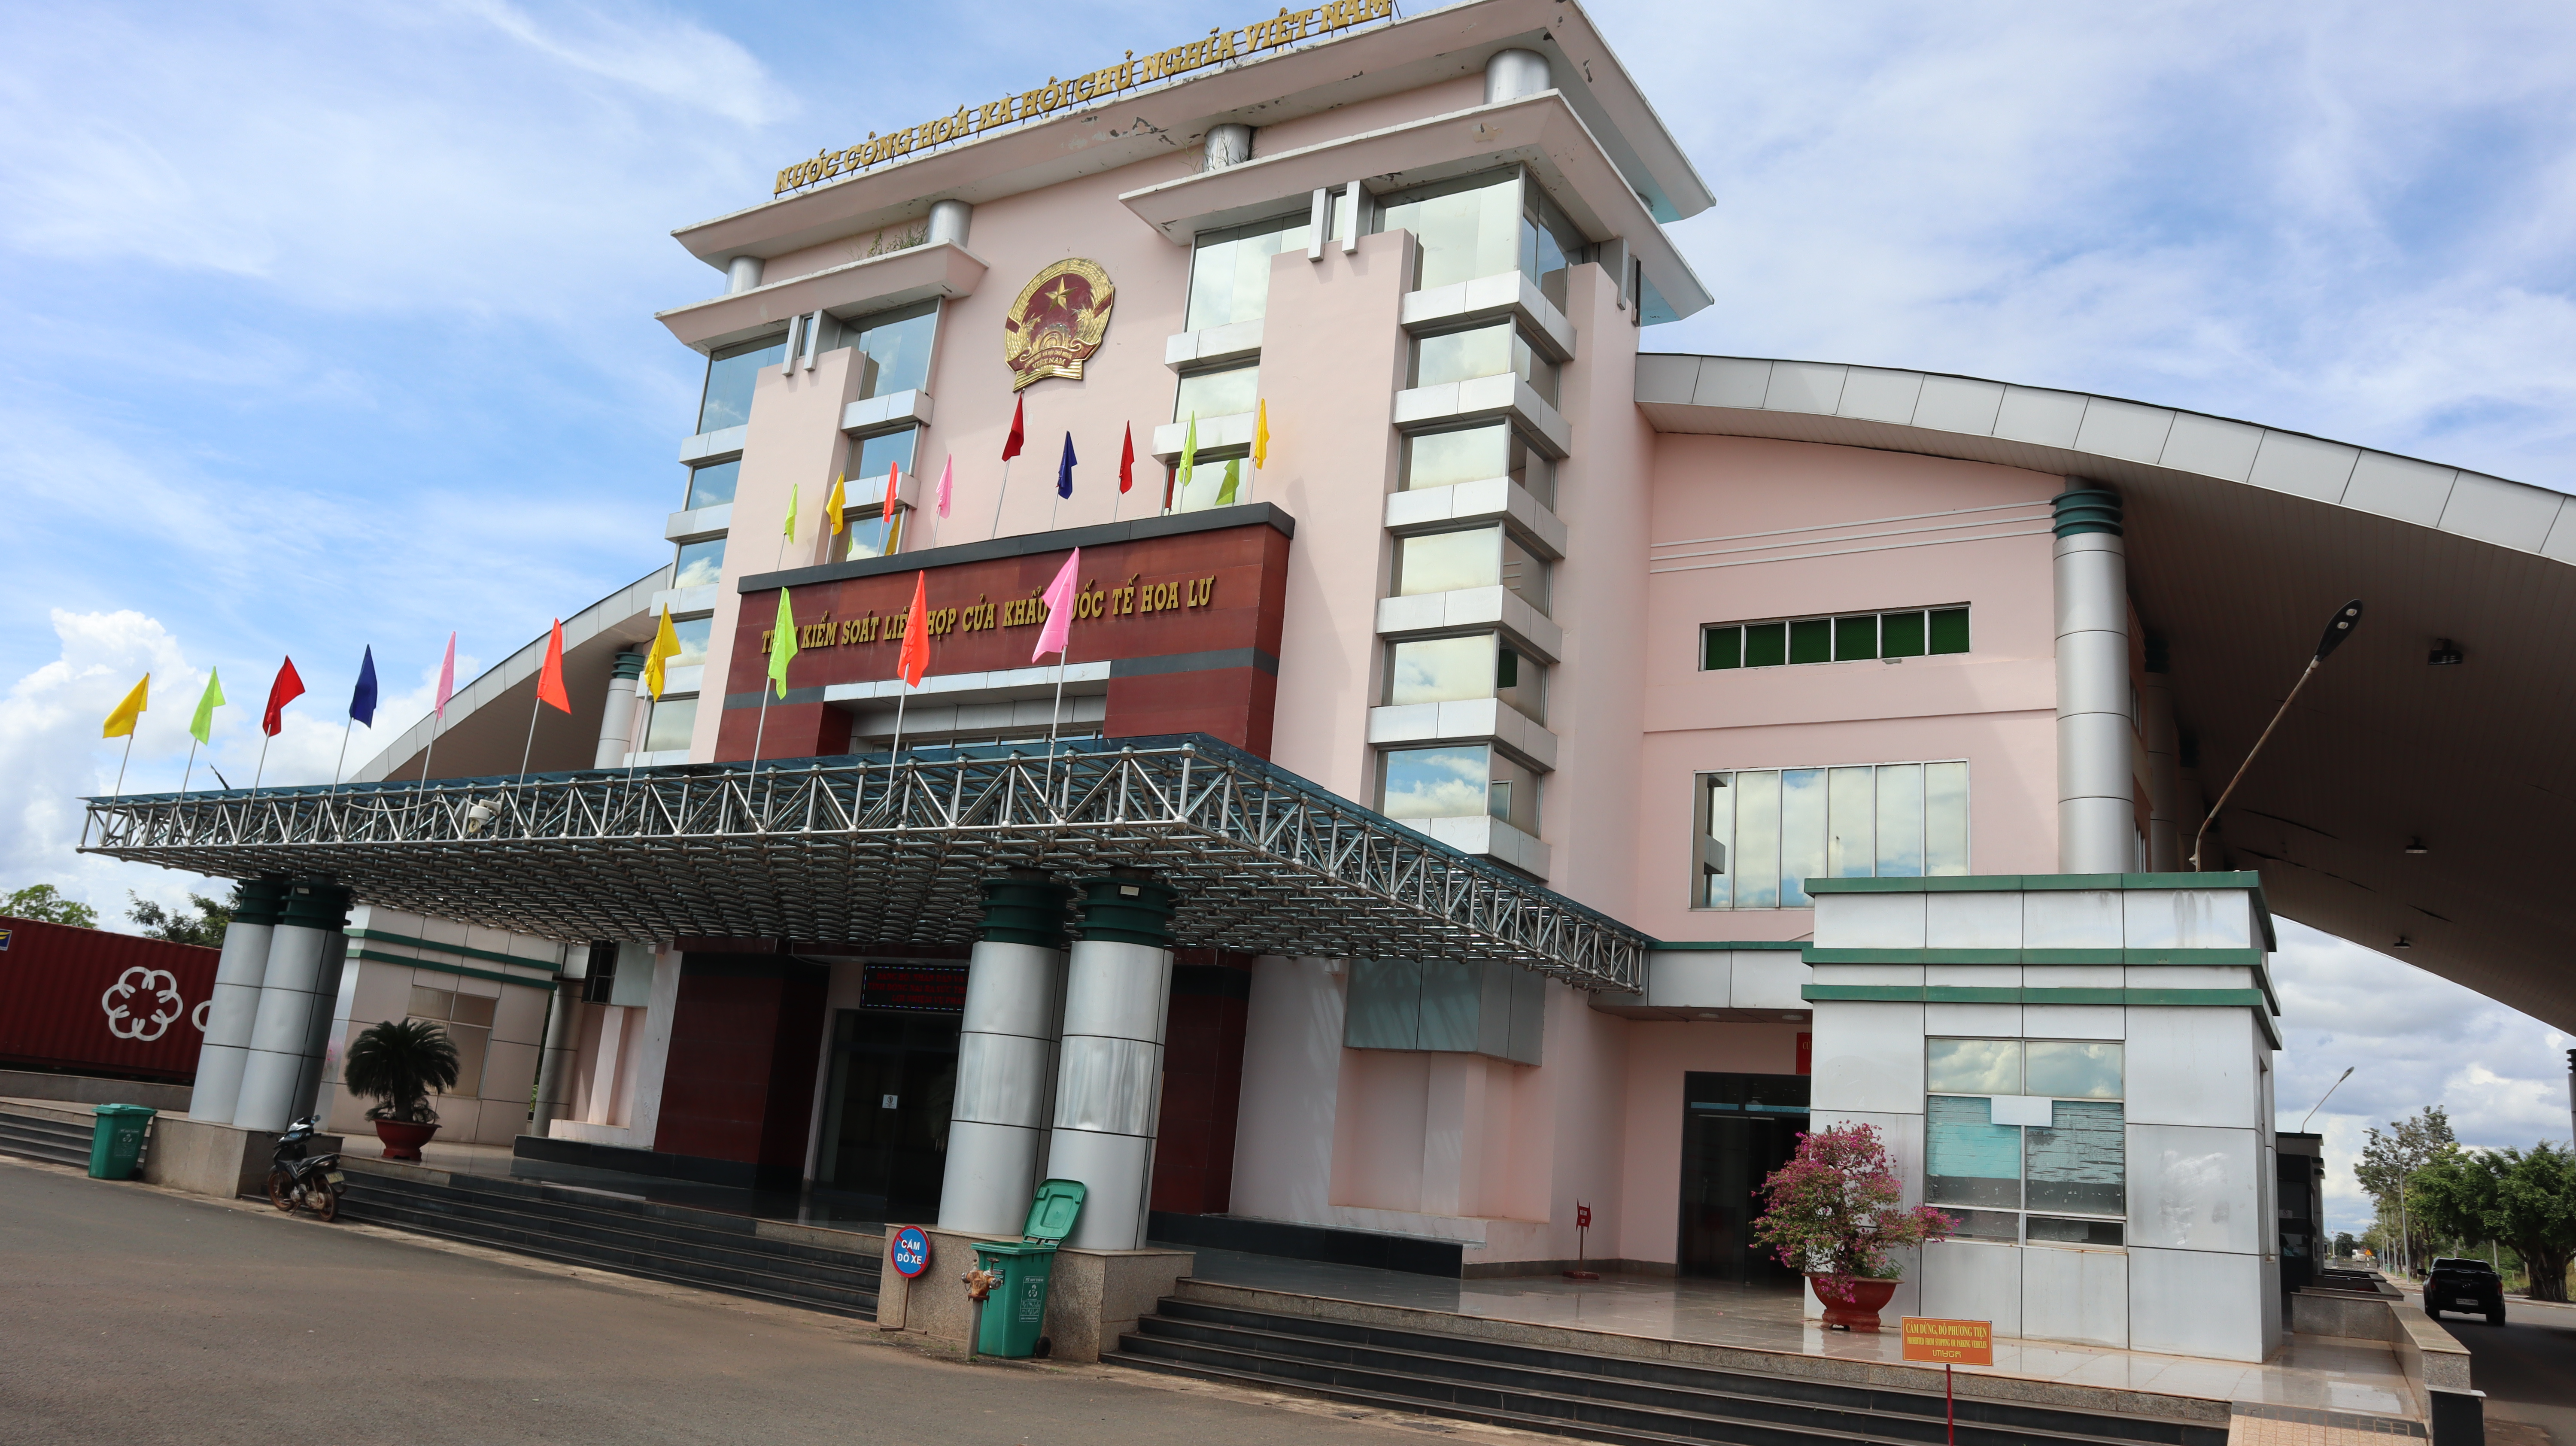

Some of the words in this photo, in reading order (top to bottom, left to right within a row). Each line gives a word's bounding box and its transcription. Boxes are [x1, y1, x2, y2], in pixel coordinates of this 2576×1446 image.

[774, 148, 841, 194] NƯỚC
[1019, 76, 1070, 118] HỘI
[1075, 49, 1134, 100] CHỦ
[1140, 27, 1235, 83] NGHĨA
[1244, 7, 1313, 52] VIỆT
[1319, 0, 1391, 33] NAM
[1049, 357, 1066, 365] NAM
[801, 611, 838, 648] KIỂM
[841, 610, 880, 645] SOÁT
[883, 606, 908, 640] LIÊ
[927, 607, 957, 641] HỢP
[962, 594, 995, 632] CỦA
[1002, 586, 1048, 627] KHẨU
[1071, 579, 1104, 620] UỐC
[1112, 573, 1139, 615] TẾ
[1140, 581, 1179, 612] HOA
[1187, 575, 1215, 608] LƯ
[911, 1255, 922, 1264] XE
[1948, 1324, 1972, 1337] PHƯƠNG
[1973, 1325, 1987, 1340] TIỆN
[1925, 1337, 1934, 1346] FROM
[1935, 1338, 1950, 1346] STOPPING
[1956, 1340, 1971, 1348] PARKING
[1971, 1340, 1987, 1349] VEHICLES
